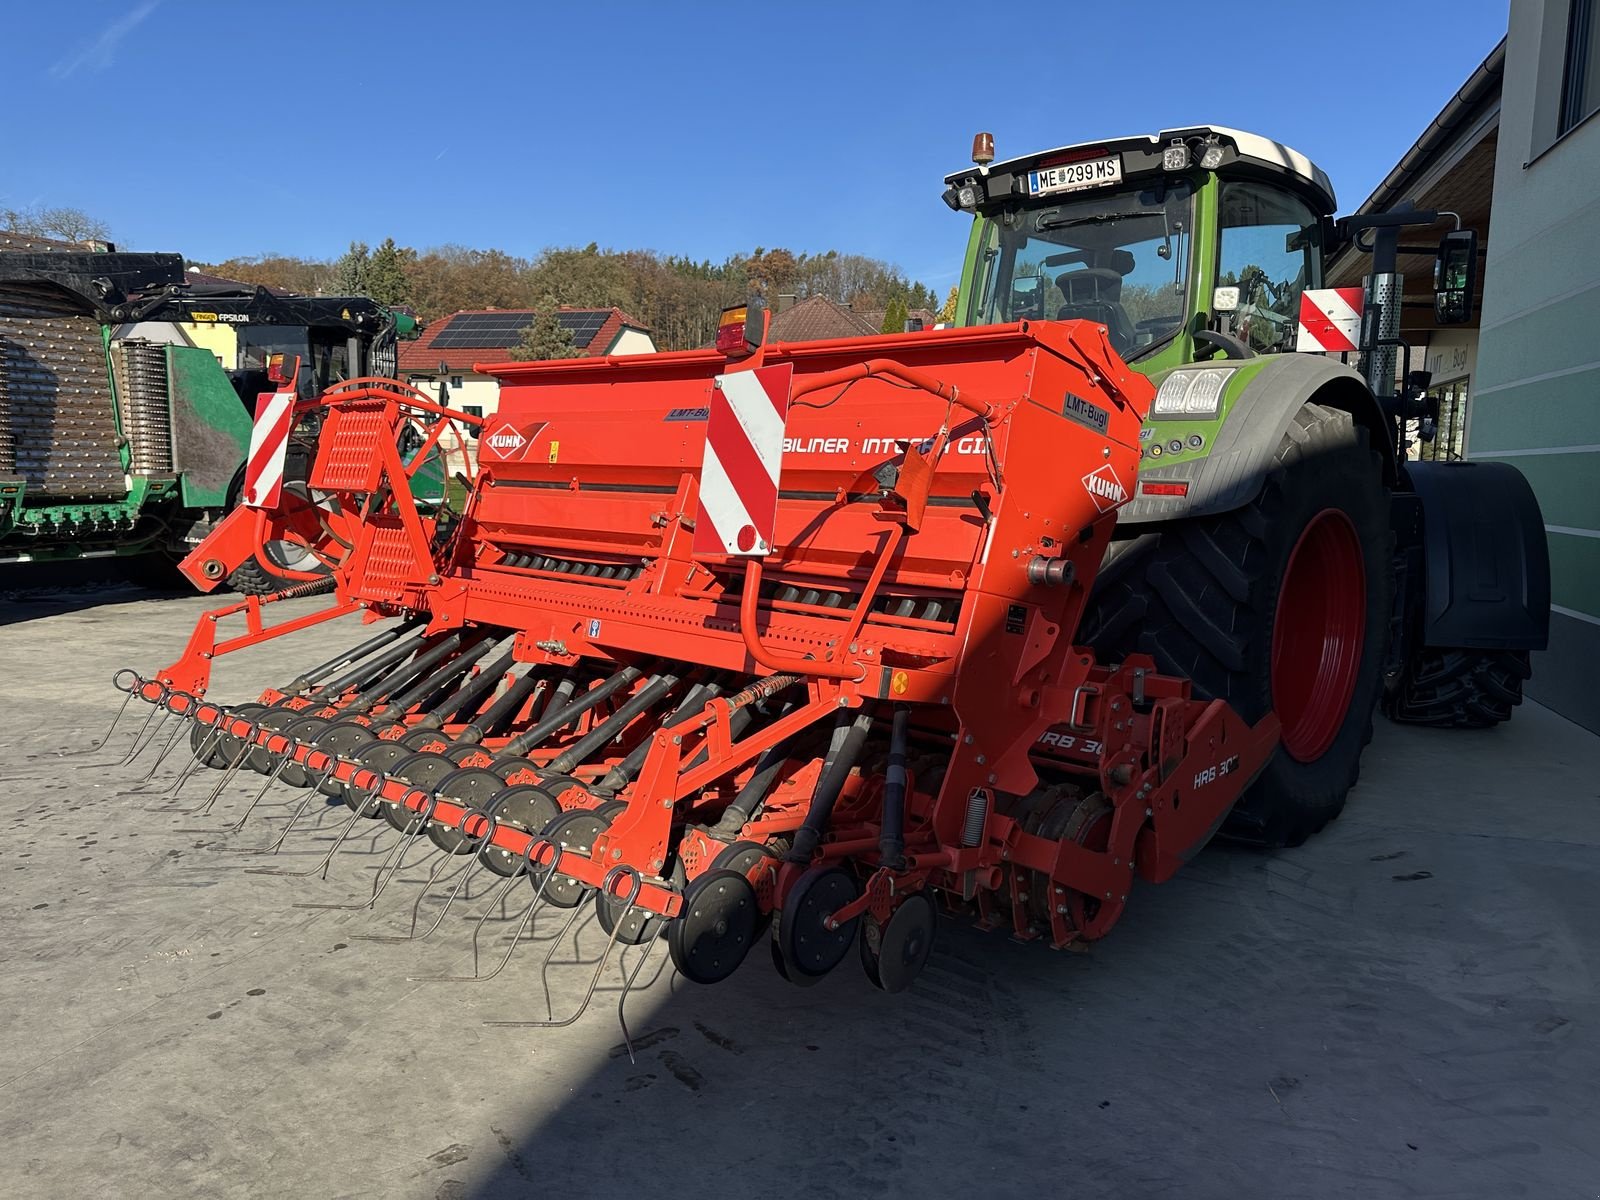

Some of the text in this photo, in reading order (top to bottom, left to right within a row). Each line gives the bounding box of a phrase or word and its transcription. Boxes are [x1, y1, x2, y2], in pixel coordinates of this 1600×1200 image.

[1040, 170, 1057, 188] ME
[1067, 164, 1094, 184] 299
[1096, 159, 1115, 178] MS
[1066, 393, 1108, 428] LMT-Bugl
[491, 435, 521, 448] KUHN
[1088, 474, 1123, 503] KUHN
[1193, 754, 1239, 790] HRB 30
